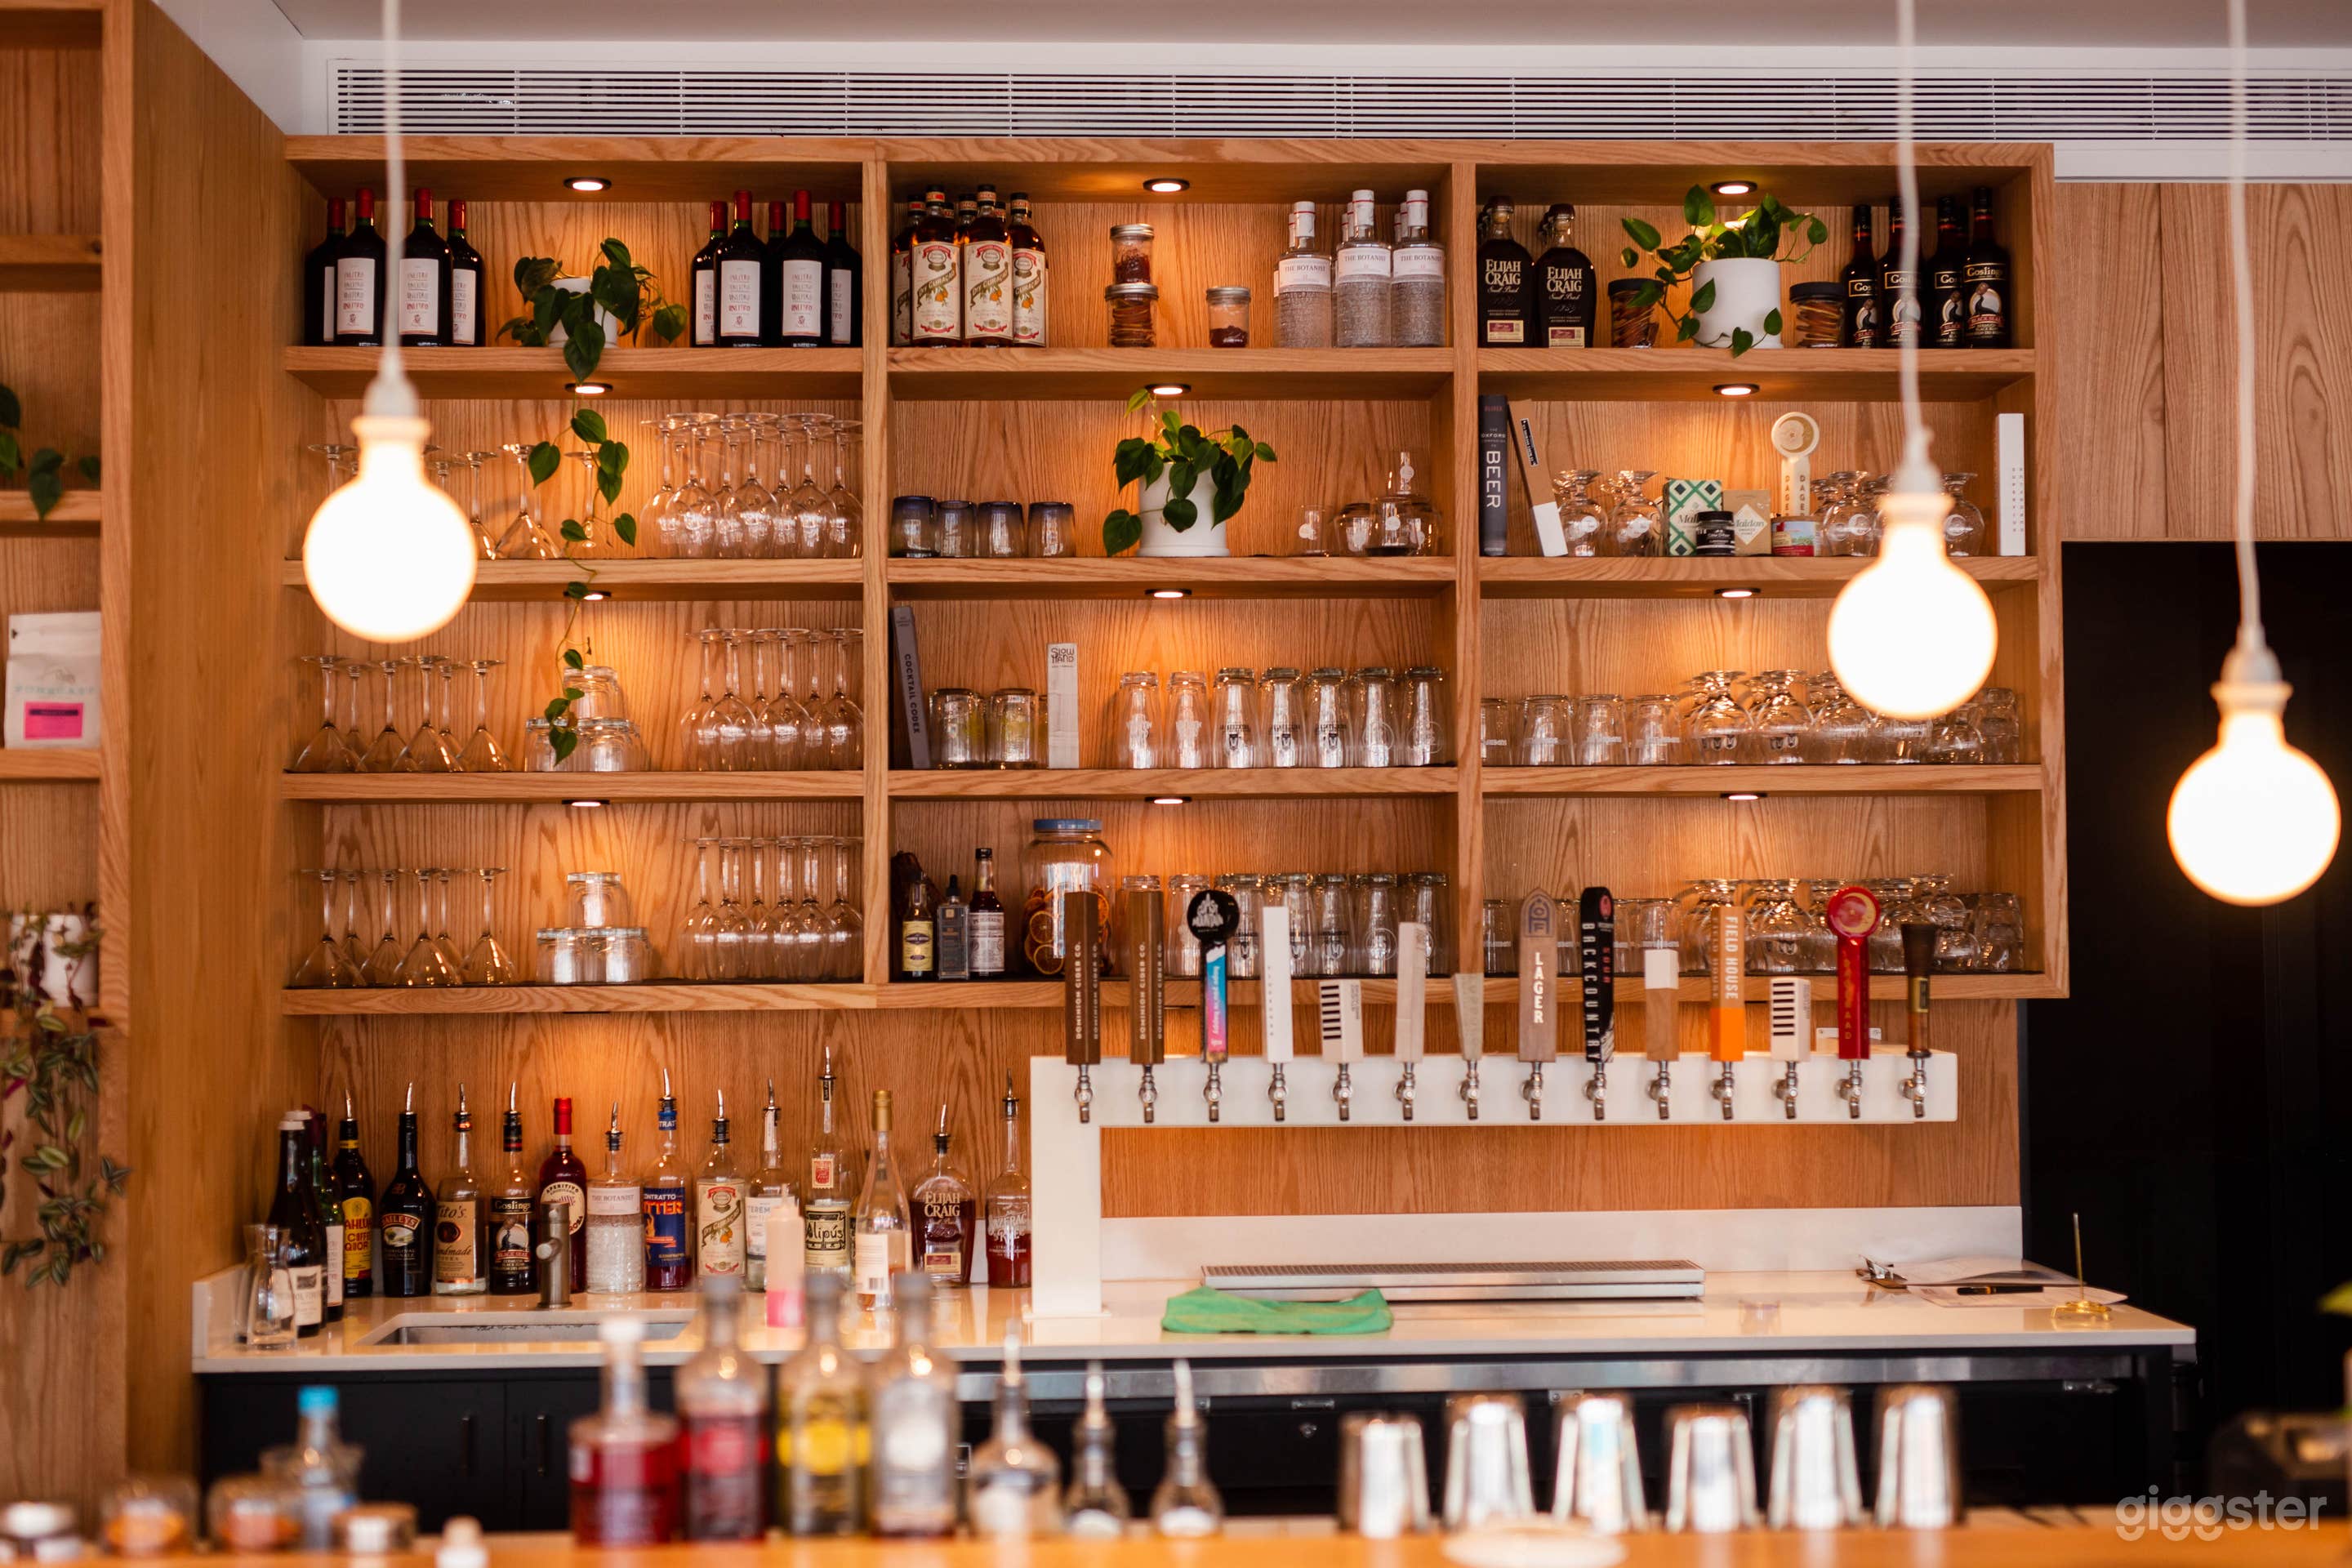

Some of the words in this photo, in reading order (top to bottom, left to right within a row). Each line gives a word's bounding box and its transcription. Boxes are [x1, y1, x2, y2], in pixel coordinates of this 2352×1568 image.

[1486, 258, 1521, 274] ELIJAH
[1547, 266, 1583, 280] ELIJAH
[1486, 271, 1521, 286] CRAIG
[1546, 278, 1582, 294] CRAIG
[1486, 451, 1501, 508] BEER
[1051, 647, 1075, 655] SLOW
[1051, 654, 1074, 663] HAND
[904, 654, 915, 700] COCKTAIL
[910, 702, 920, 733] CODEX
[1725, 916, 1738, 952] FIELD
[1602, 947, 1611, 984] SOUR
[1725, 958, 1738, 1000] HOUSE
[1534, 952, 1544, 1023] LAGER
[1582, 923, 1600, 1060] BACKCOUNTRY
[546, 1183, 579, 1193] APERITIVO
[604, 1194, 634, 1202] BOTANIST
[924, 1192, 960, 1206] ELIJAH
[495, 1200, 531, 1212] Goslings
[644, 1201, 684, 1214] ITTER
[924, 1203, 960, 1218] CRAIG
[345, 1214, 372, 1230] AHLÚ
[347, 1232, 371, 1242] COFFE
[805, 1222, 844, 1242] Alipús
